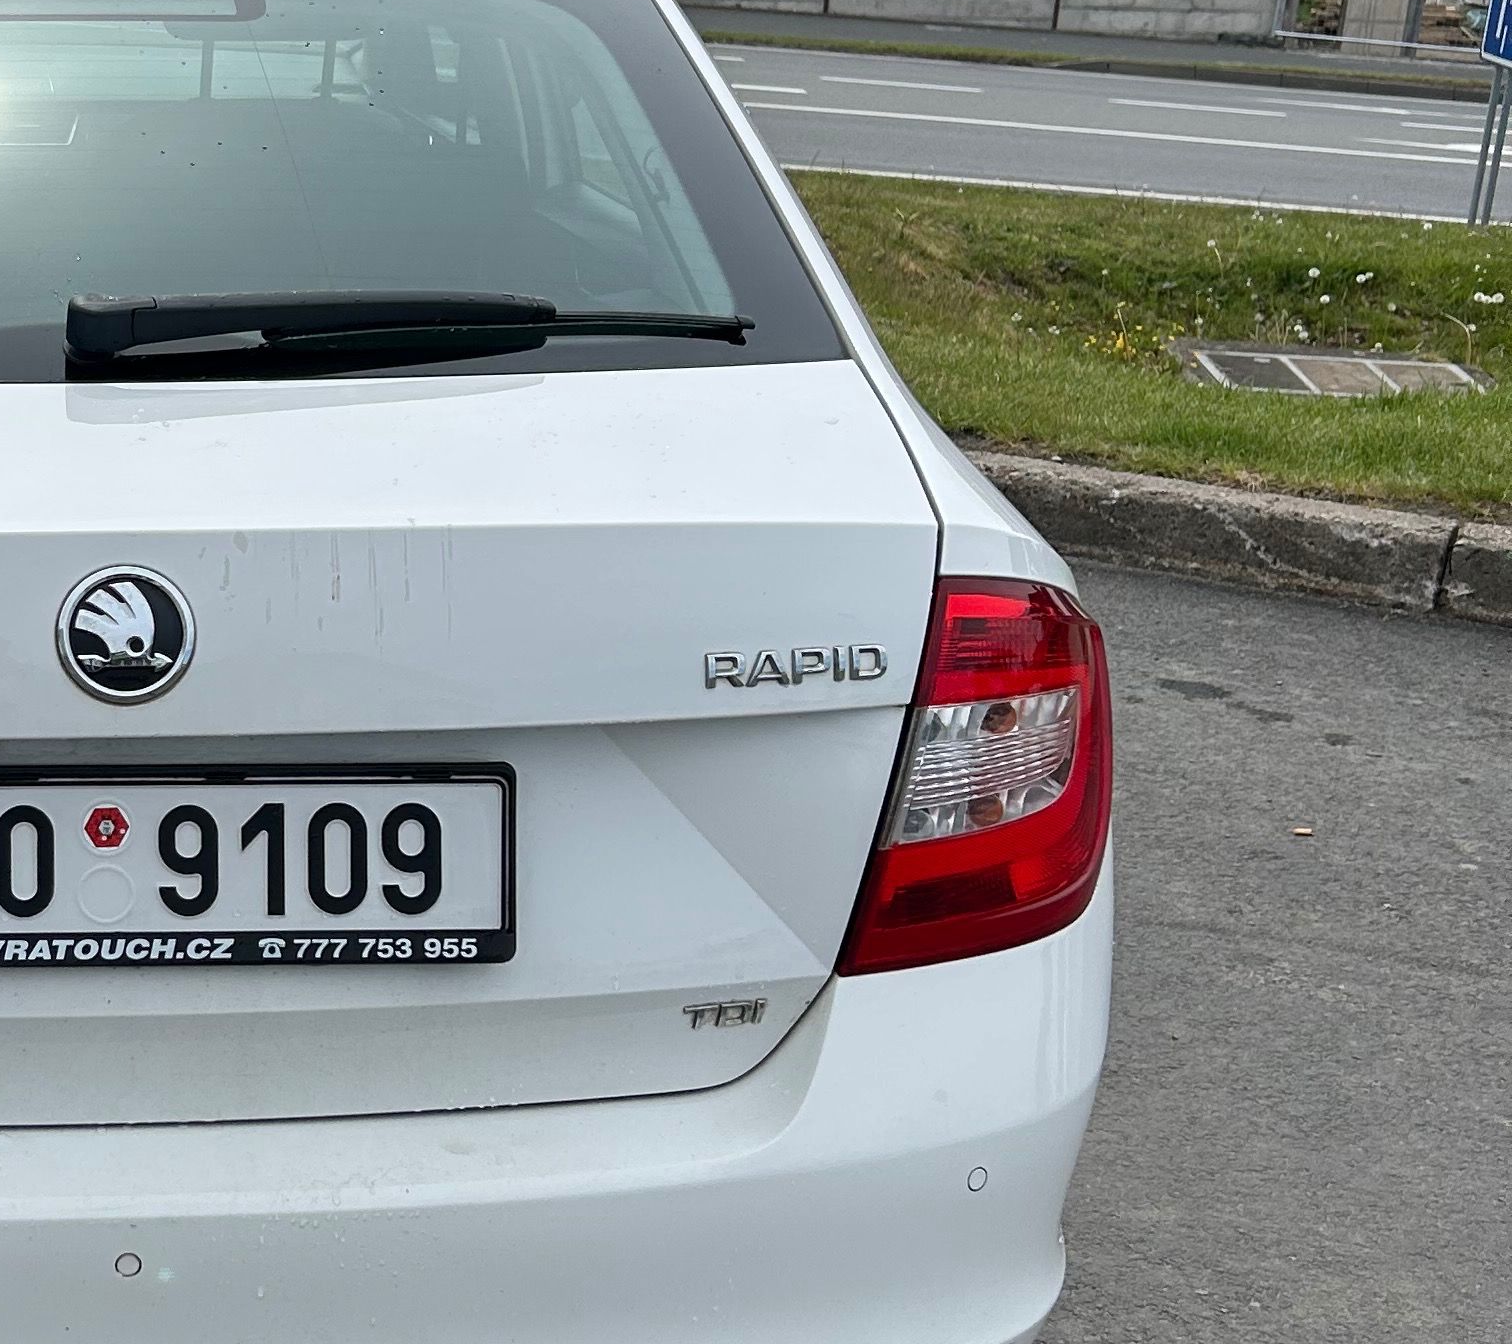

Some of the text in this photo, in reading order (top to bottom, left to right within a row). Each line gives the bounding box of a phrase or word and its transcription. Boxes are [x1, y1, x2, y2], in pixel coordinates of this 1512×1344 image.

[703, 642, 889, 691] RAPID
[157, 801, 443, 917] 9109
[293, 937, 348, 960] 777
[358, 937, 414, 960] 753
[423, 937, 479, 960] 955
[683, 998, 767, 1030] TDI
